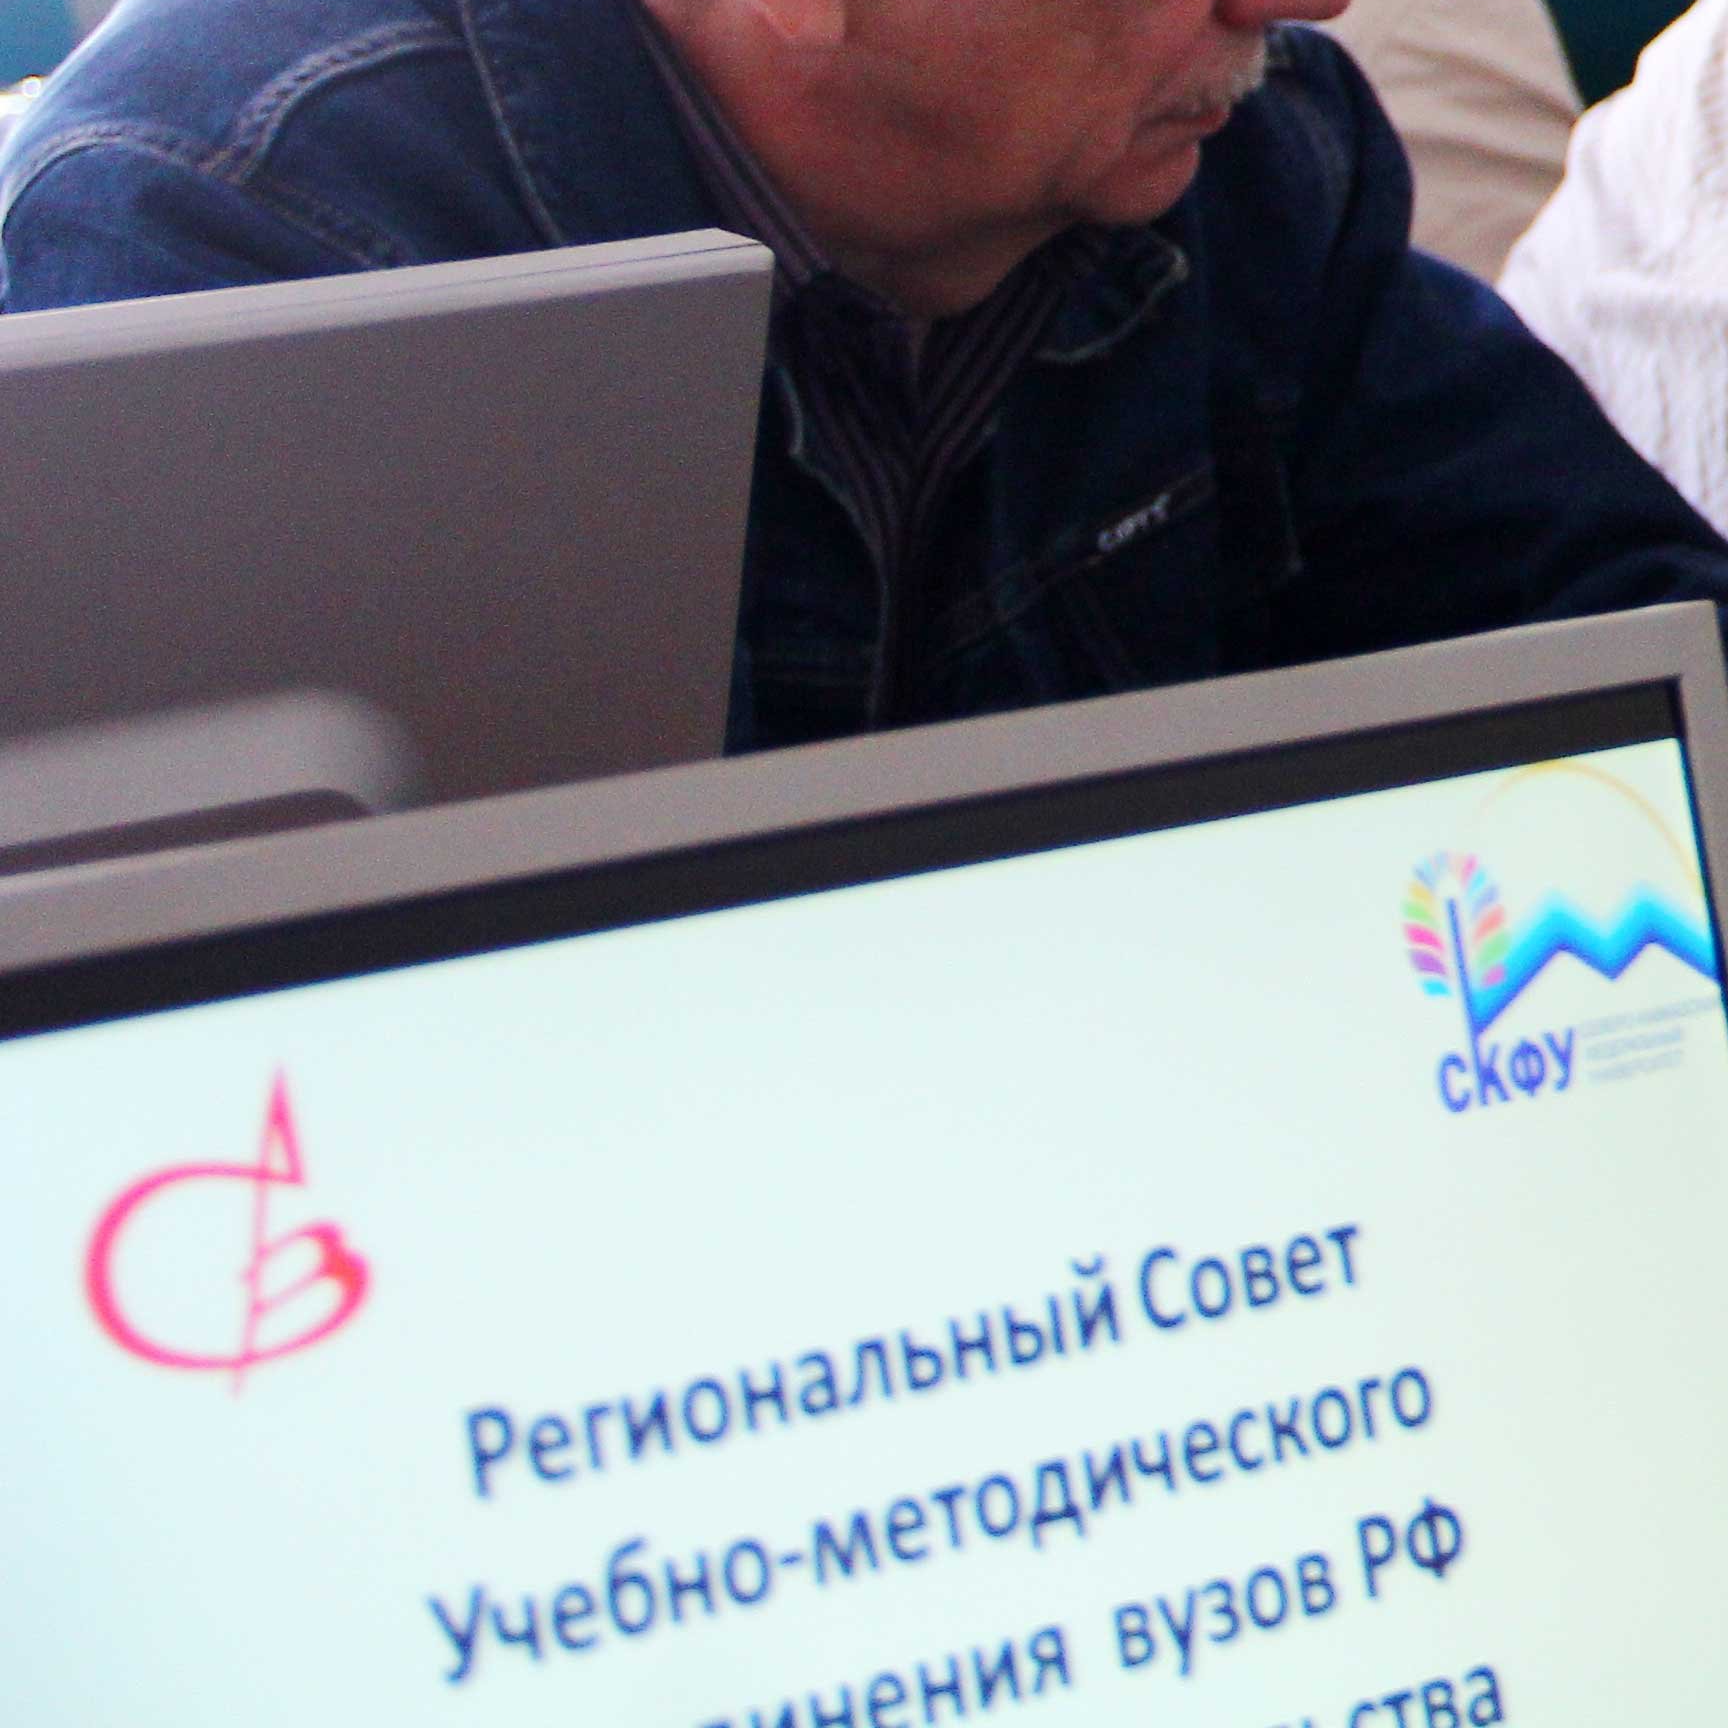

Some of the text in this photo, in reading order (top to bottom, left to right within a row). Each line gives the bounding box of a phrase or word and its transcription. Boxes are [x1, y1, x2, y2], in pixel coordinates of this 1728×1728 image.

[1437, 1027, 1575, 1113] СКФУ
[466, 1223, 1361, 1500] Региональный Совет
[426, 1366, 1433, 1686] Учебно-методического
[1113, 1551, 1337, 1676] вузов
[1356, 1497, 1462, 1598] РФ
